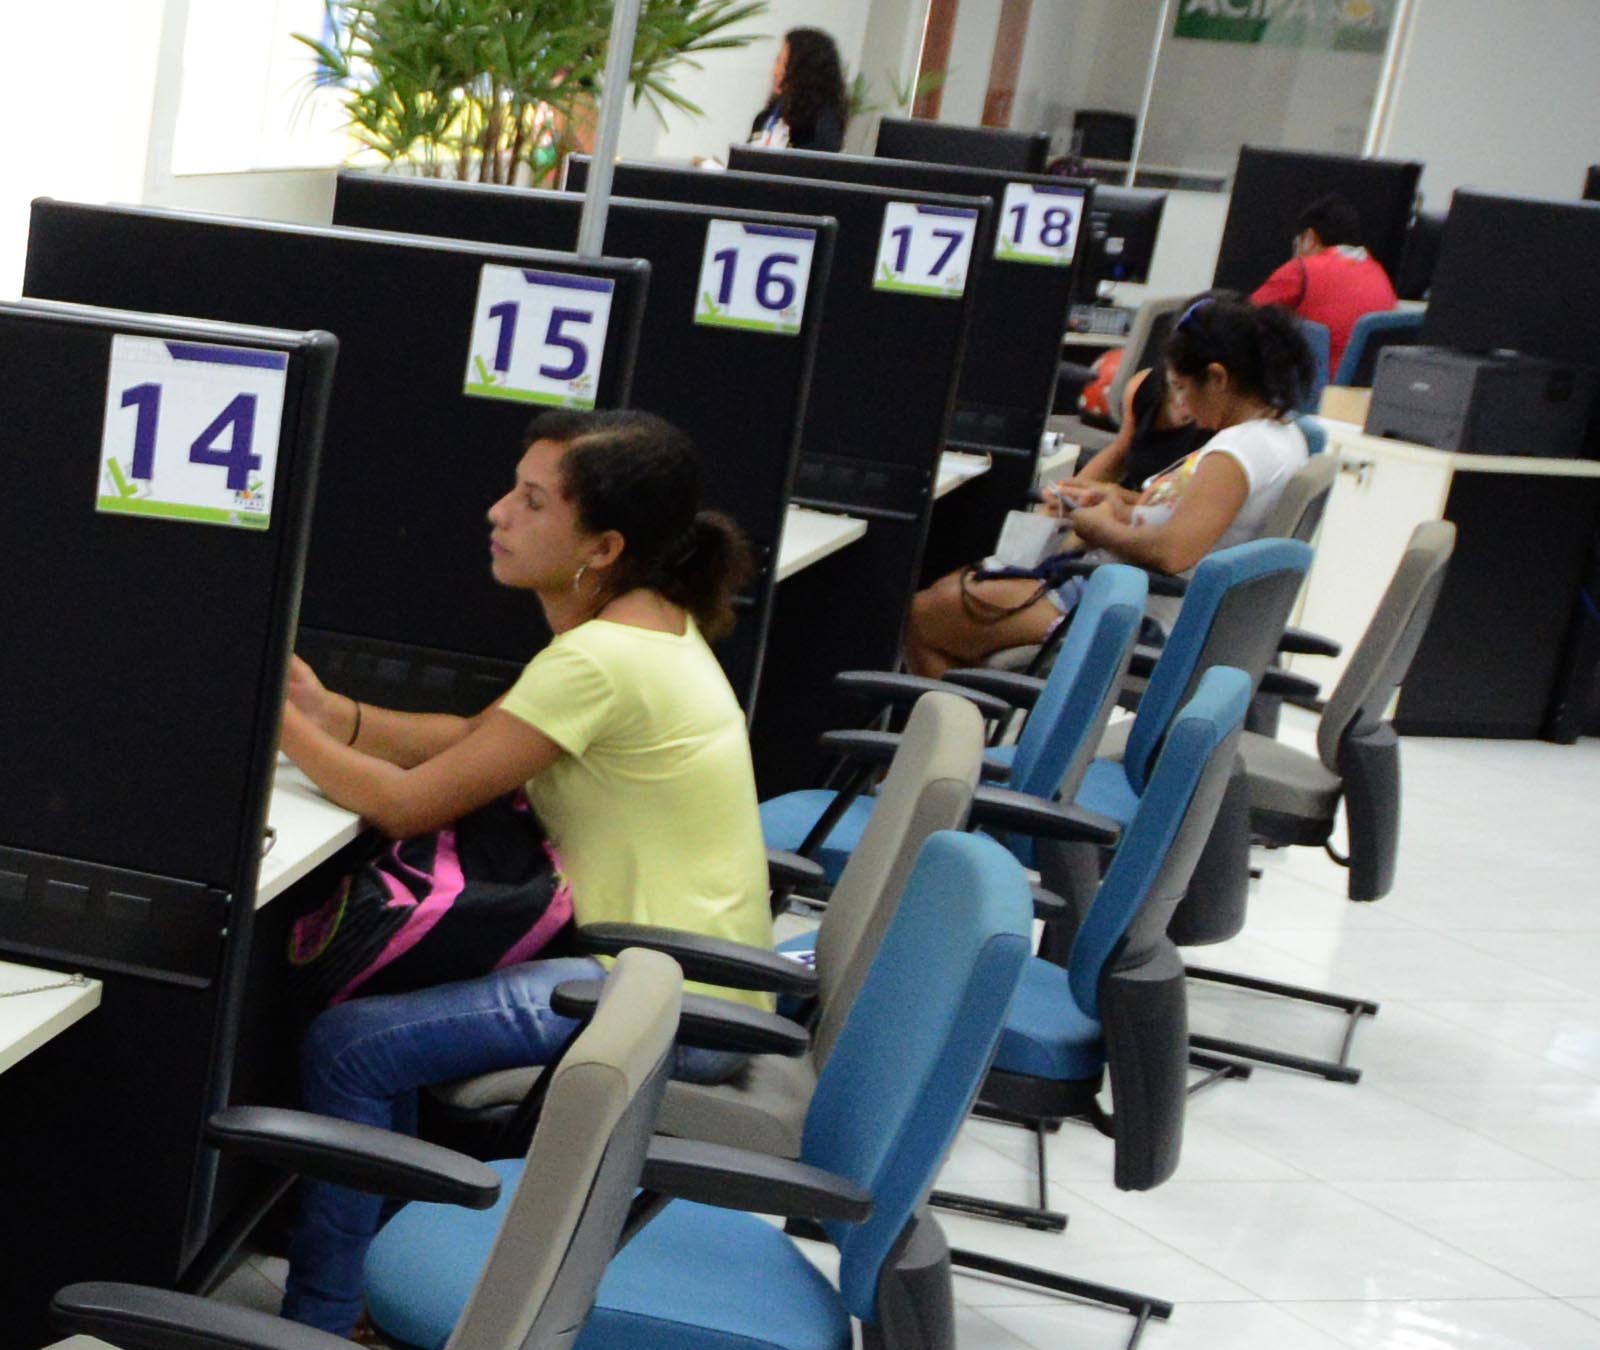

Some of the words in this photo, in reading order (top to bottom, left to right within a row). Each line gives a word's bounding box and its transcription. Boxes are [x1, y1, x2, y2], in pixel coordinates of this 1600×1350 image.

[892, 225, 965, 276] 17
[1010, 203, 1072, 248] 18
[714, 247, 799, 311] 16
[488, 301, 593, 381] 15
[120, 381, 263, 491] 14
